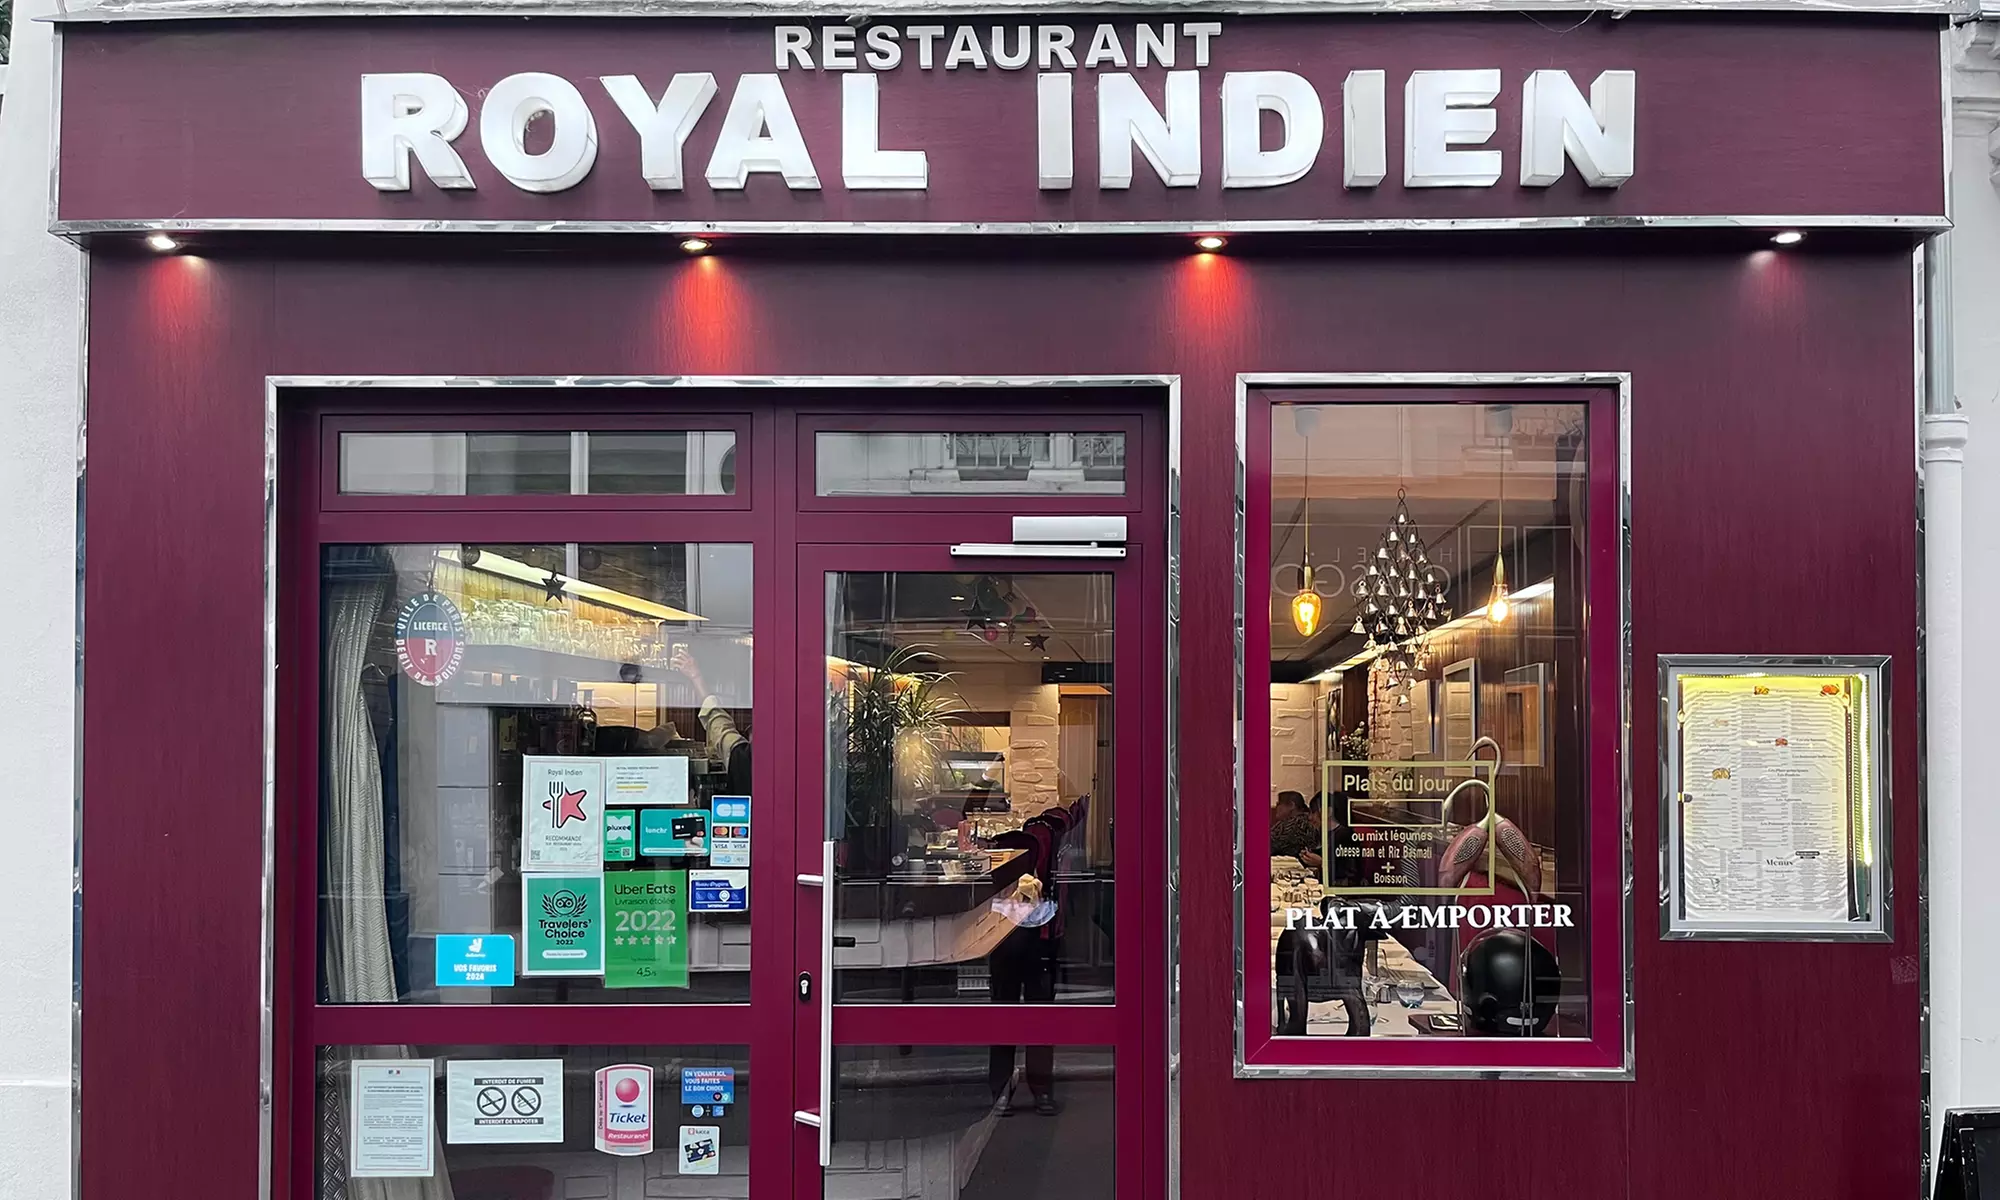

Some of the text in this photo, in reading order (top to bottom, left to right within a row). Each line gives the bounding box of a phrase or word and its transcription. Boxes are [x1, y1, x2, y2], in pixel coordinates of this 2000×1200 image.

[775, 22, 1221, 69] RESTAURANT
[361, 69, 1637, 192] ROYAL INDIEN
[397, 598, 420, 630] VILLE
[442, 600, 463, 632] PARIS
[413, 622, 448, 631] LICENCE
[424, 638, 437, 656] R
[396, 639, 413, 670] DEBIT
[435, 641, 464, 686] BOISSONS
[1344, 775, 1453, 794] Plats du jour
[1351, 829, 1433, 842] ou mixt légumes
[1362, 847, 1375, 857] nan
[1378, 846, 1385, 858] et
[1388, 845, 1400, 858] Riz
[1403, 846, 1433, 859] Basmati
[614, 884, 676, 895] Uber Eats
[615, 898, 648, 906] Livraison
[615, 910, 676, 931] 2022
[1286, 906, 1361, 930] PLAT
[1400, 904, 1574, 930] EMPORTER
[545, 929, 586, 938] Choice
[454, 964, 497, 973] VOS FAVORIS
[466, 973, 485, 981] 2024
[609, 1112, 647, 1124] Ticket
